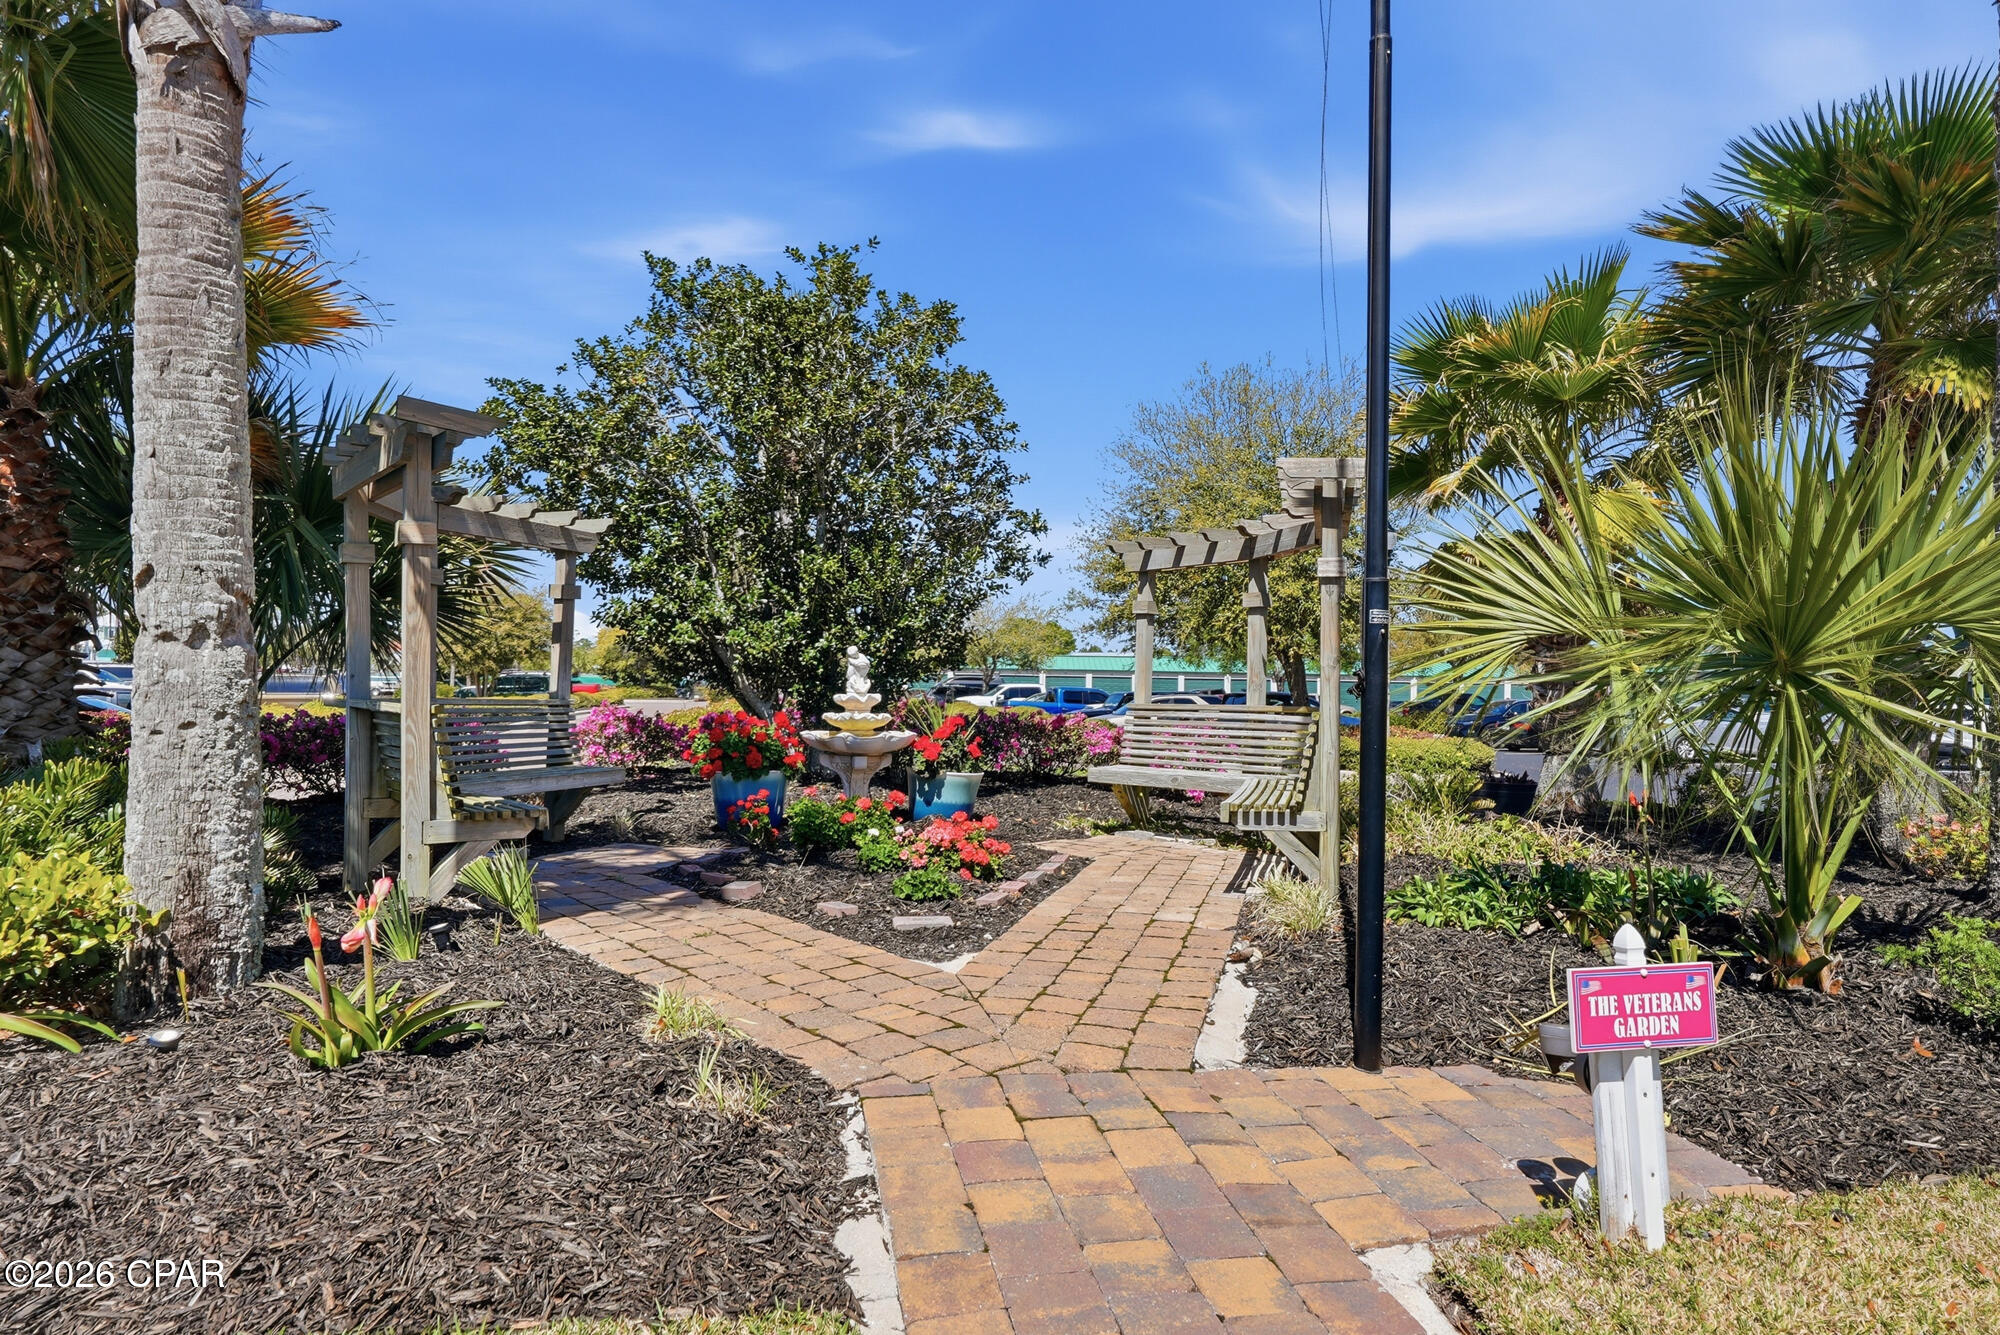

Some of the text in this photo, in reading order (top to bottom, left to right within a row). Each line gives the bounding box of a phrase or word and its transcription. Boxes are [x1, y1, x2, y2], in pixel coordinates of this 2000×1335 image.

[1588, 990, 1702, 1016] THE VETERANS
[1613, 1015, 1680, 1038] GARDEN
